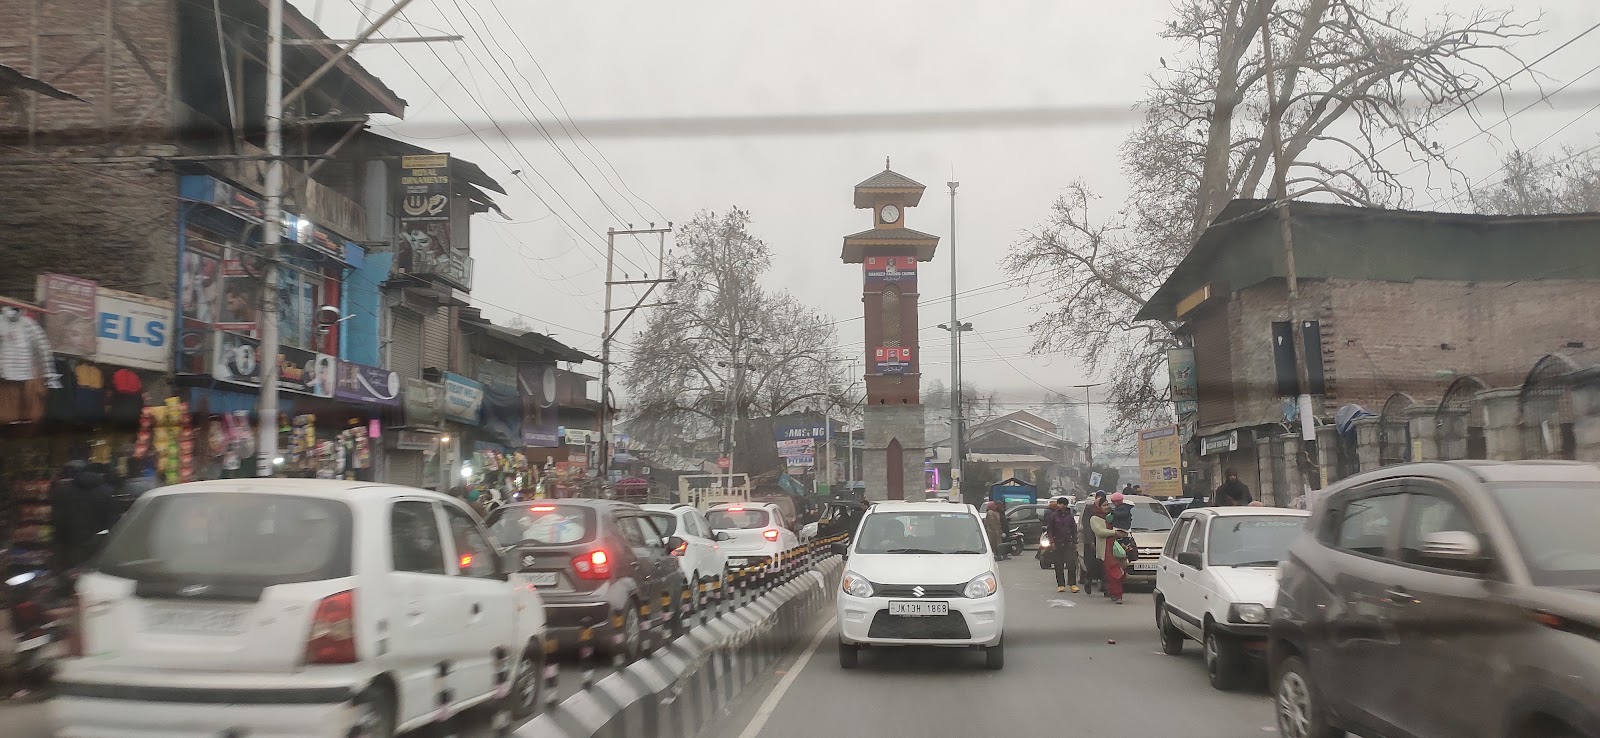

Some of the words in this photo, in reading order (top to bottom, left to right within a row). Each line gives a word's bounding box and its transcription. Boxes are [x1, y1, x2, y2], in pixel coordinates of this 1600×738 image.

[412, 168, 437, 176] ROYAL
[401, 176, 448, 184] ORNAMENTS
[896, 604, 921, 613] JK13H
[927, 604, 947, 613] 1868
